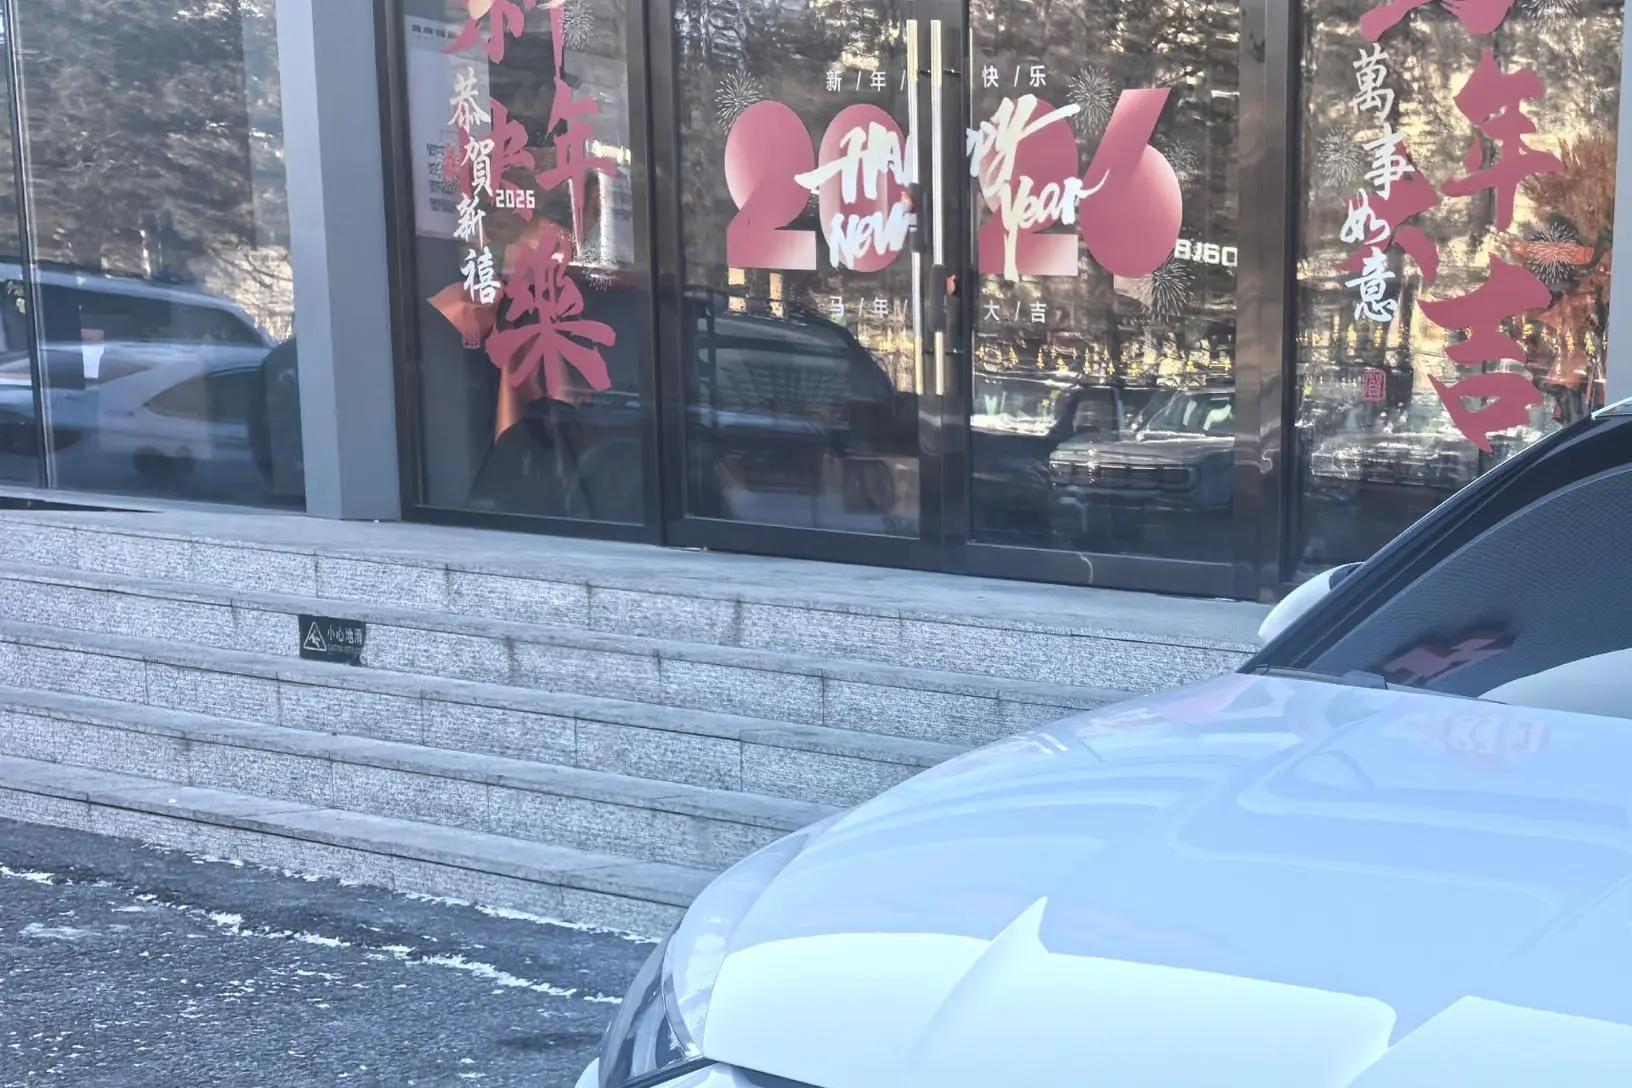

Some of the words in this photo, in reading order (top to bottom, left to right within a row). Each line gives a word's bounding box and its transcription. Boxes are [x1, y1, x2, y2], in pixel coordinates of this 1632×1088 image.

[448, 66, 502, 304] 恭賀新禧
[495, 189, 536, 209] 2026
[1340, 43, 1415, 322] 萬事如意
